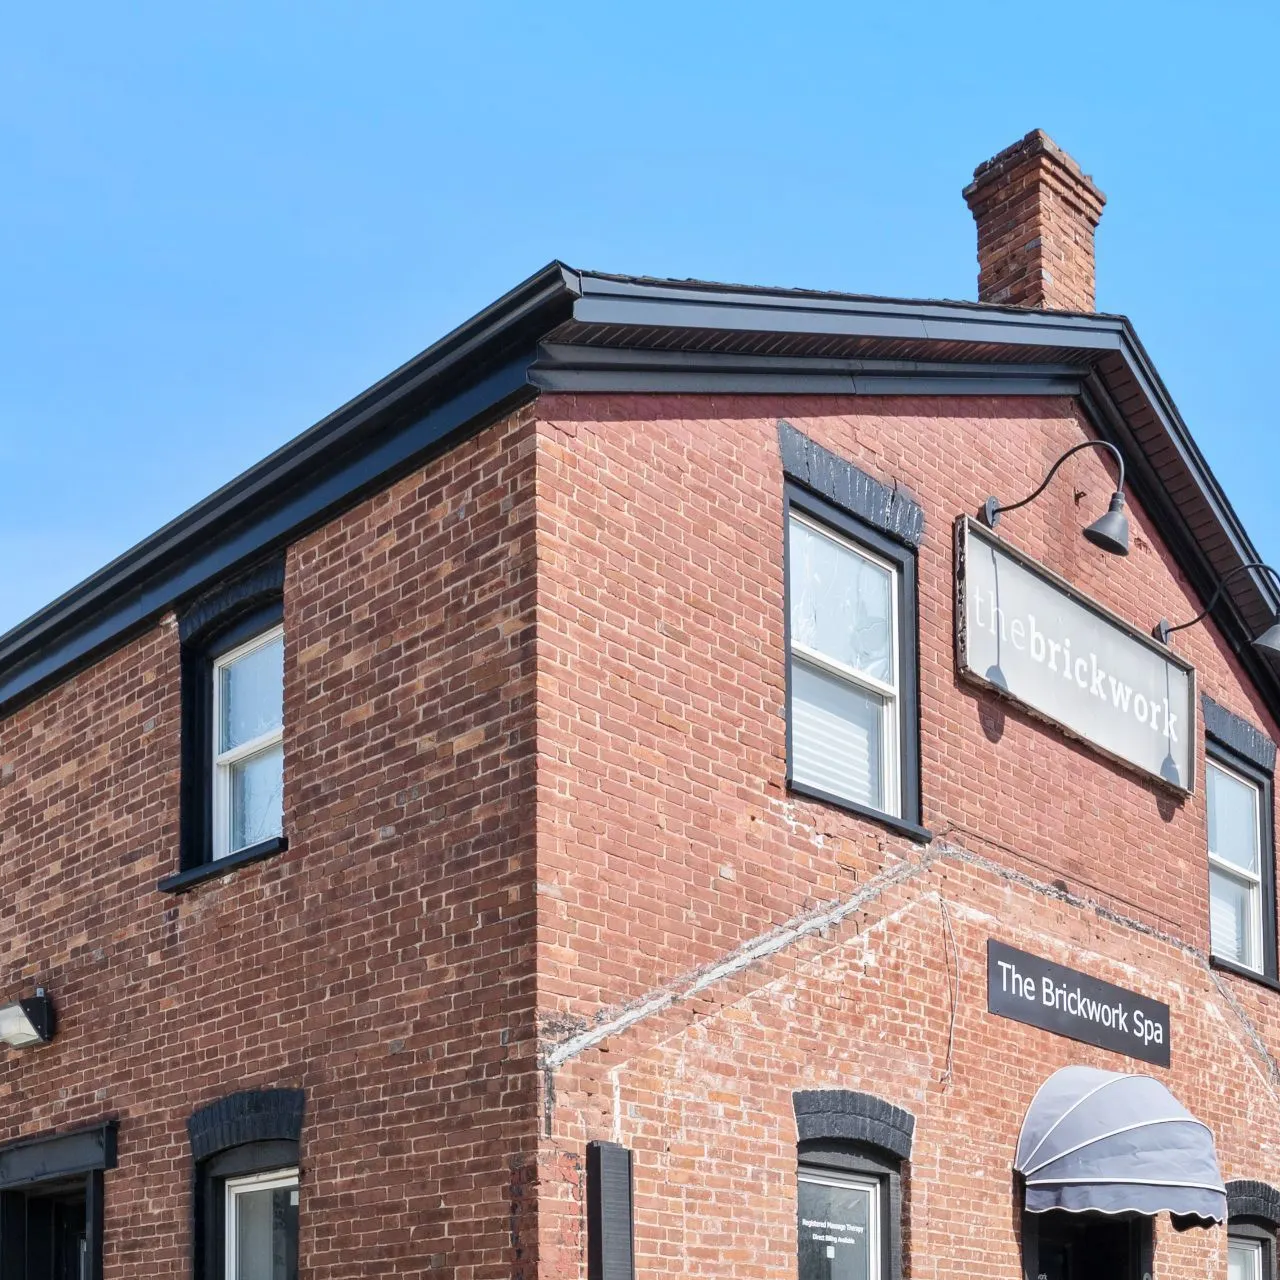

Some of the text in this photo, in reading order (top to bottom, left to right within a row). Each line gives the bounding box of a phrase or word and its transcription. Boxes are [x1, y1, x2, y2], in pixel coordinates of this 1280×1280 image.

[998, 960, 1163, 1045] The Brickwork Spa
